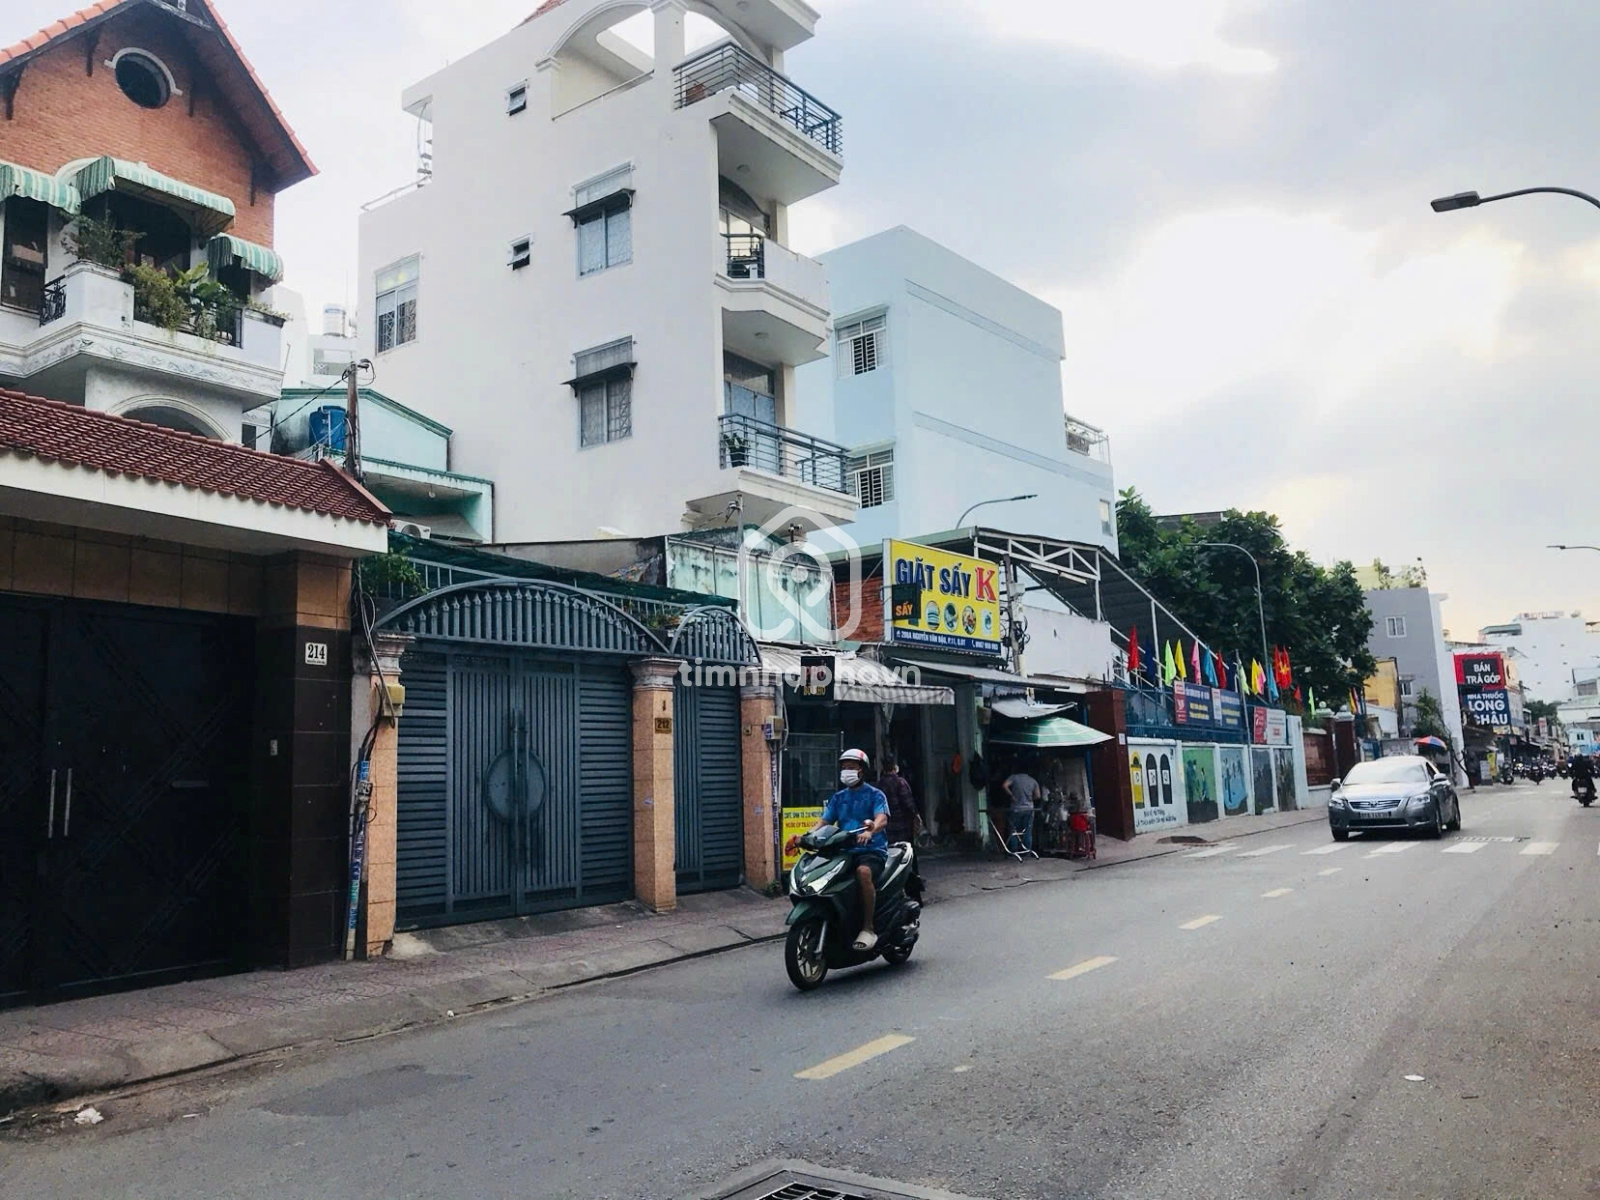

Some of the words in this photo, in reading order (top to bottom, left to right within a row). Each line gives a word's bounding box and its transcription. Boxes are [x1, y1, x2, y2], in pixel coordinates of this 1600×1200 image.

[940, 562, 971, 598] SẤY
[975, 566, 997, 604] K
[895, 601, 913, 616] SẤY
[307, 643, 326, 660] 214
[1473, 662, 1491, 672] BÁN
[1466, 672, 1483, 684] TRẢ
[1484, 672, 1501, 684] GÓP
[1482, 691, 1505, 700] THUỐC
[1468, 700, 1505, 711] LONG
[657, 719, 670, 729] 212
